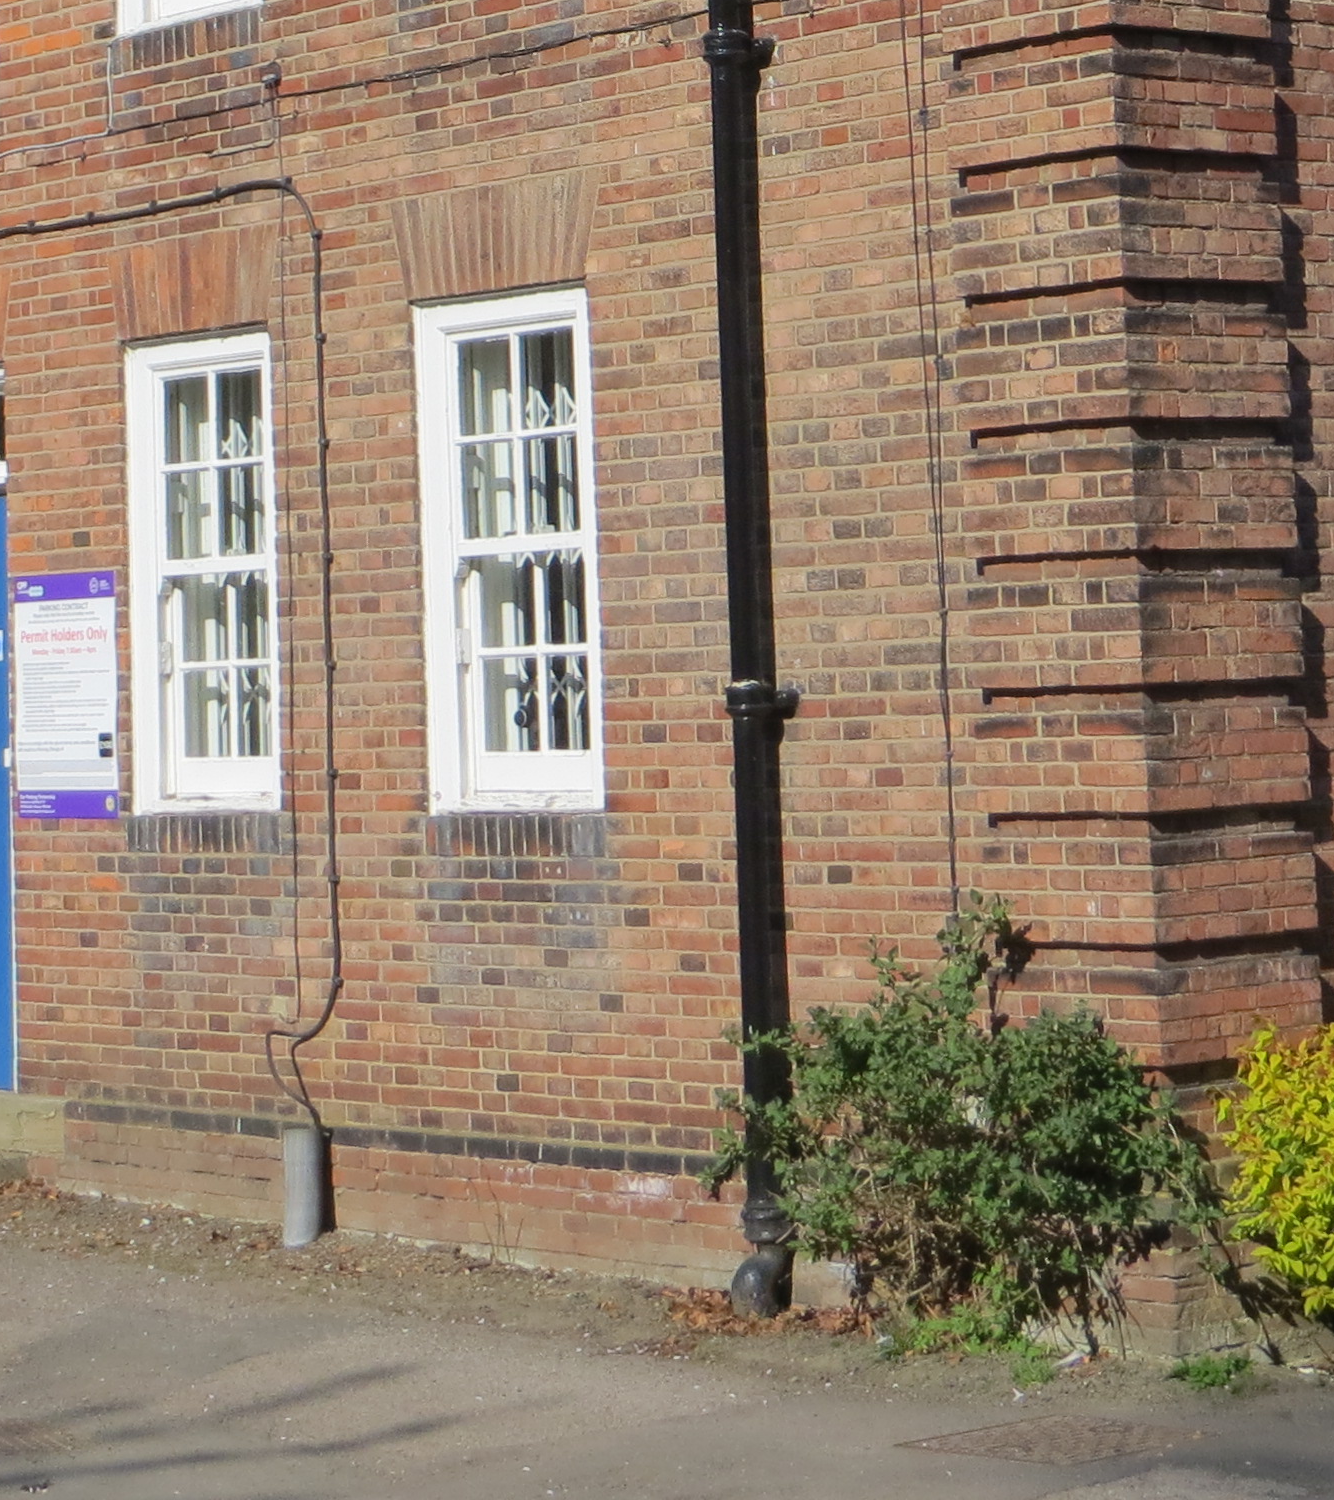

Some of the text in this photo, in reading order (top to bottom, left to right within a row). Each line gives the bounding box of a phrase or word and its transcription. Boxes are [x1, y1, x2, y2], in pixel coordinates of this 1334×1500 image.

[20, 625, 108, 643] Permit Holders Only
